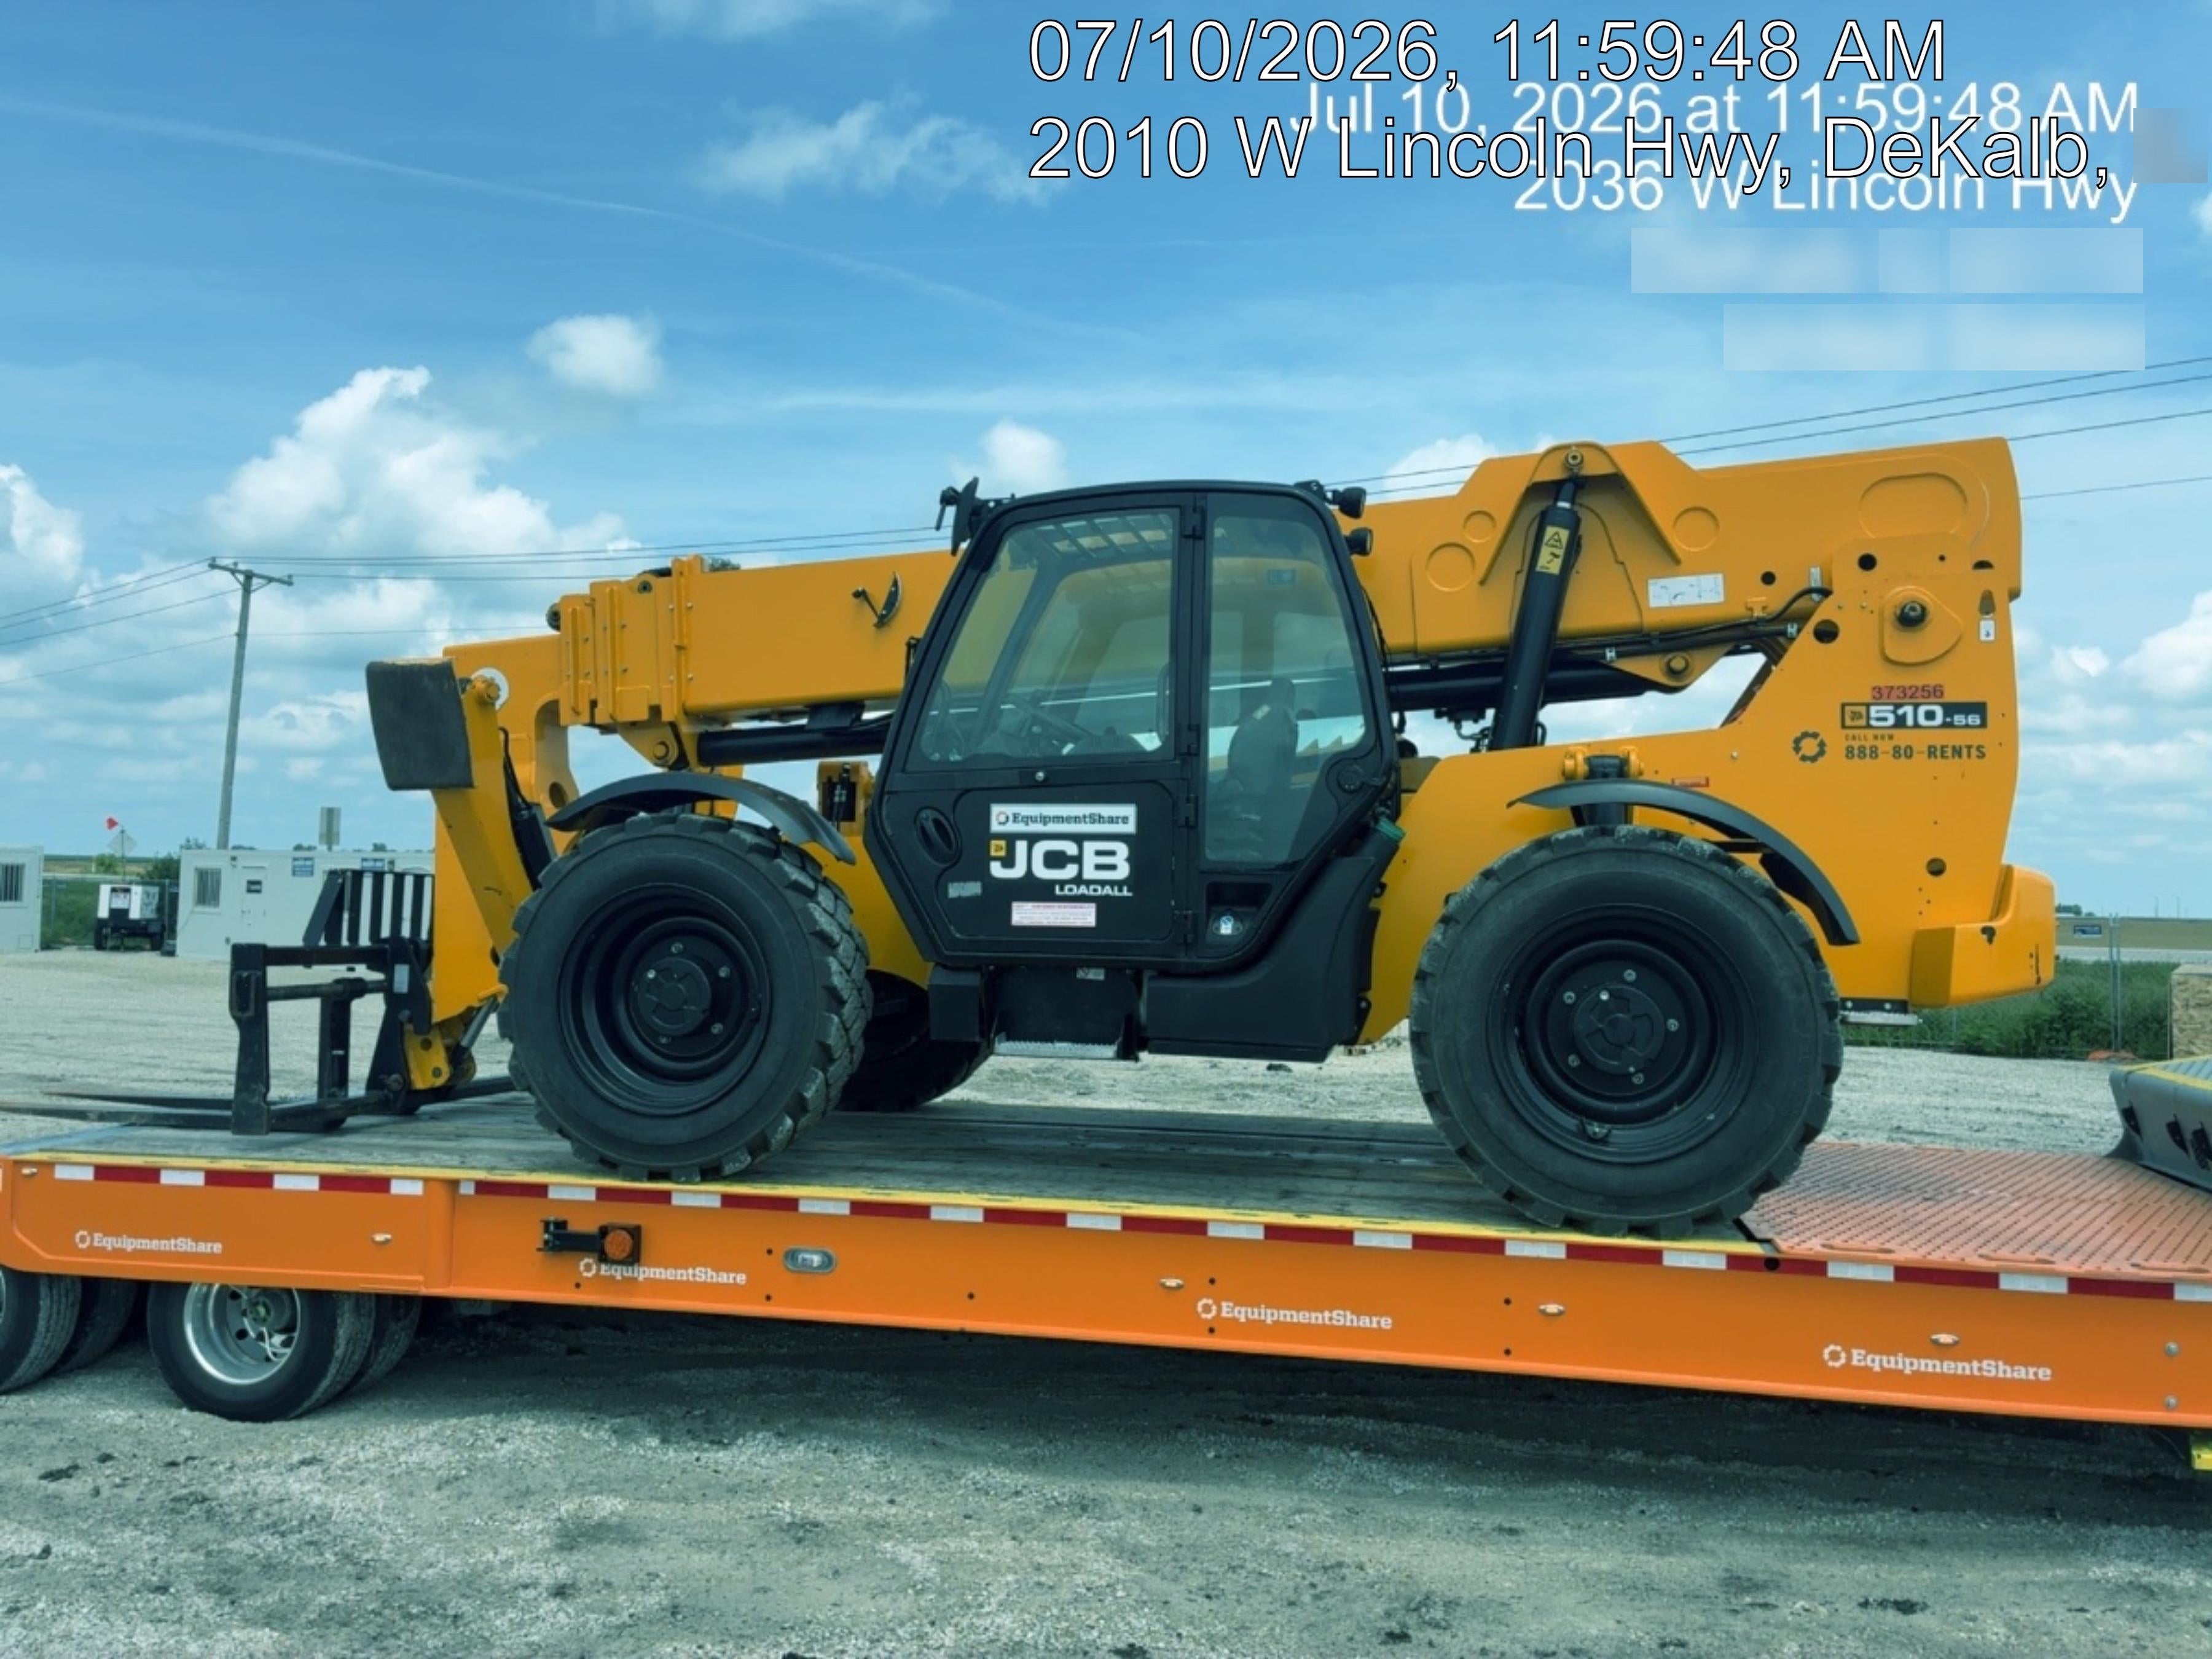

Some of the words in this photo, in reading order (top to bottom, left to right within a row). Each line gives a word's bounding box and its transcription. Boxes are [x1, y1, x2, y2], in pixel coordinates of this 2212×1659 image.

[1871, 684, 1945, 700] 373256
[1011, 812, 1129, 826] EquipmentShare
[989, 839, 1131, 880] JCB
[1055, 884, 1133, 896] LOADALL
[92, 1232, 222, 1255] EquipmentShare
[600, 1262, 747, 1285] EquipmentShare
[1220, 1301, 1393, 1330] EquipmentShare
[1849, 1347, 2052, 1381] EquipmentShare
